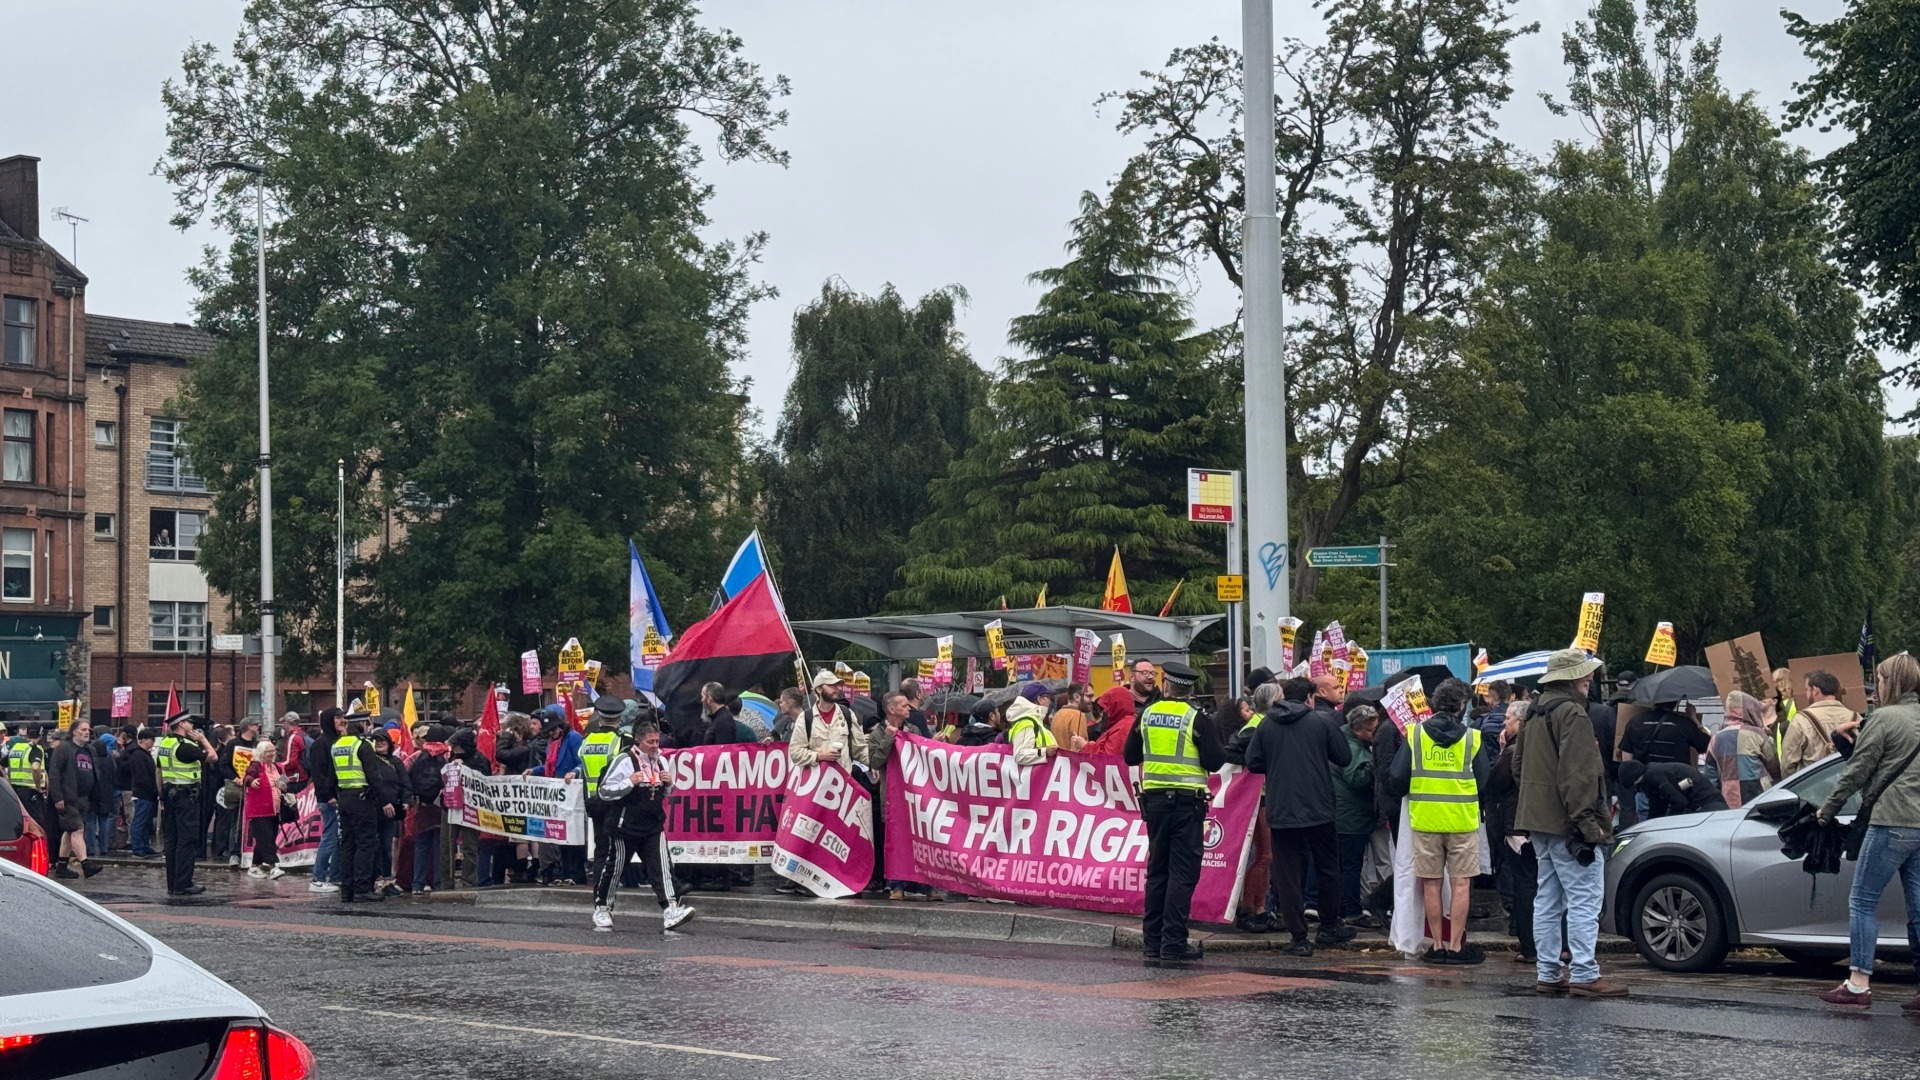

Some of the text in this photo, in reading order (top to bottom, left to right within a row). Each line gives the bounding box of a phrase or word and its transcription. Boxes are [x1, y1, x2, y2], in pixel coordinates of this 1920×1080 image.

[1587, 603, 1604, 613] STO
[1586, 611, 1603, 623] THE
[1585, 621, 1601, 632] FAR
[1583, 630, 1598, 640] RIG
[1003, 639, 1051, 650] ALTMARKET
[1149, 714, 1181, 727] POLICE
[585, 745, 608, 754] POLICE
[900, 740, 1033, 800] WOMEN
[461, 774, 567, 802] EDINBURGH & THE LOTHIANS
[471, 793, 551, 817] STAND UP TO RACISM
[668, 795, 725, 833] THE
[799, 816, 820, 834] TUC
[904, 790, 1150, 863] THE FAR RIGH
[912, 840, 969, 875] REFUGEES
[969, 855, 1010, 881] ARE
[1010, 859, 1106, 889] WELCOME
[1108, 867, 1148, 892] HER
[1201, 859, 1227, 868] RACISM
[1007, 887, 1023, 895] Racism
[1024, 887, 1046, 897] Scotland
